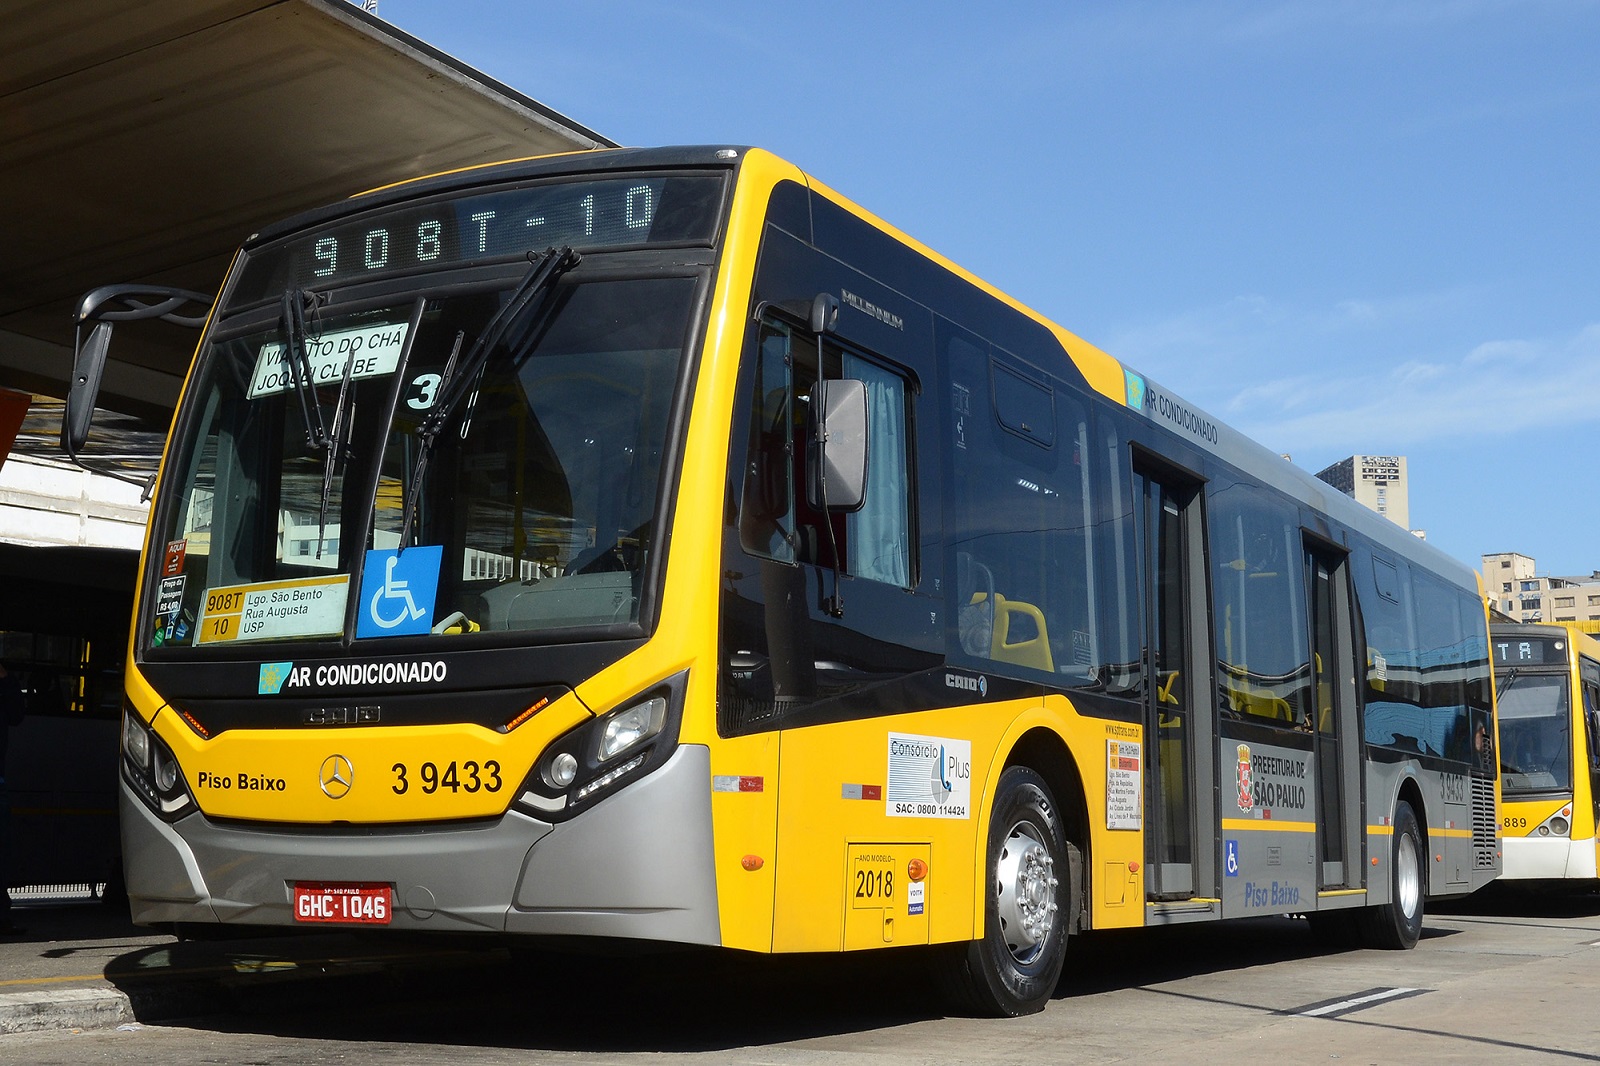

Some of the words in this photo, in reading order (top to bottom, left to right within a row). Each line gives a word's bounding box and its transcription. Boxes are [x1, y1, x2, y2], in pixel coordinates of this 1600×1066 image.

[841, 288, 903, 331] MILLENNIUM
[338, 336, 363, 354] DO
[368, 326, 403, 348] CHÁ
[407, 373, 442, 410] 3
[1145, 387, 1157, 411] AR
[1160, 394, 1218, 445] CONDICIONADO
[207, 592, 243, 612] 908T
[248, 594, 269, 608] Lgo.
[271, 591, 290, 602] São
[292, 589, 323, 601] Bento
[245, 608, 264, 620] Rua
[266, 604, 309, 619] Augusta
[213, 618, 229, 636] 10
[243, 621, 264, 634] USP
[288, 666, 310, 688] AR
[315, 660, 447, 686] CONDICIONADO
[945, 673, 978, 691] CAIO
[891, 740, 938, 759] Consórcio
[391, 763, 409, 795] 3
[420, 760, 503, 794] 9433
[948, 756, 970, 779] Plus
[1252, 755, 1295, 778] PREFEITURA
[1296, 761, 1305, 779] DE
[198, 772, 232, 789] Piso
[237, 773, 286, 791] Baixo
[1254, 777, 1275, 807] SÃO
[1277, 784, 1305, 810] PAULO
[895, 803, 915, 814] SAC:
[917, 804, 937, 815] 0800
[939, 805, 966, 816] 114424
[1504, 817, 1527, 828] 889
[859, 854, 870, 862] ANO
[871, 855, 892, 863] MODELO
[856, 870, 893, 898] 2018
[1244, 882, 1267, 908] Piso
[1271, 880, 1299, 906] Baixo
